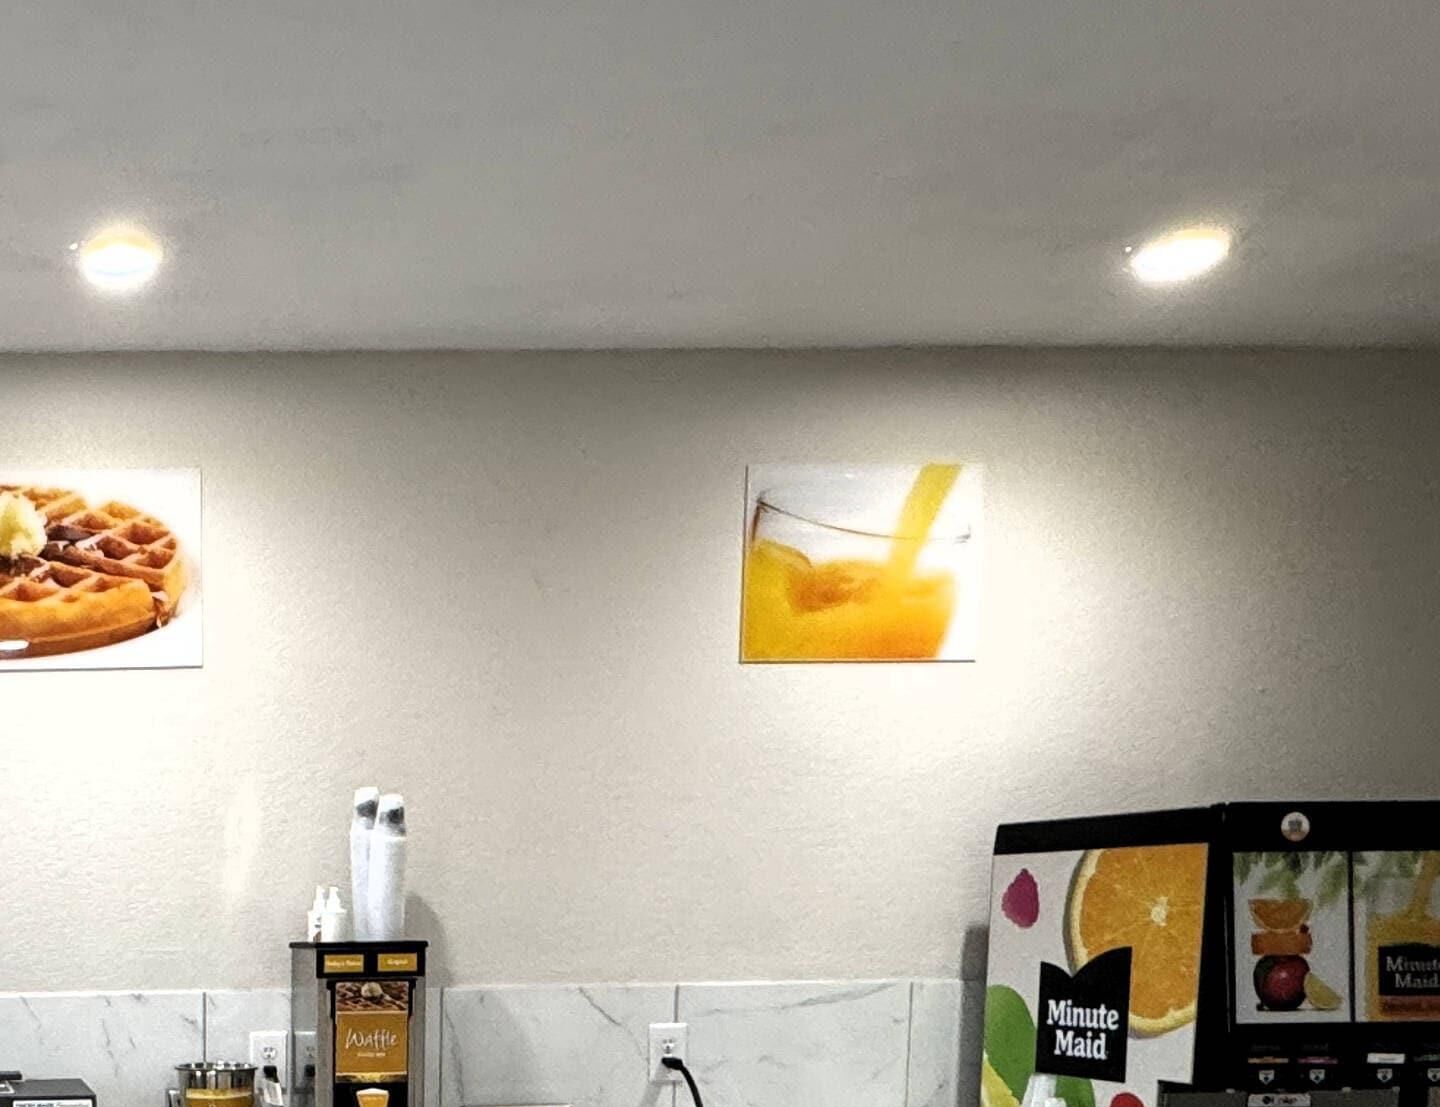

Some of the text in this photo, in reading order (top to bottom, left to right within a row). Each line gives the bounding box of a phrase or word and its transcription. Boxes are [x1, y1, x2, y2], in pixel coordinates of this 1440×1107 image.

[1385, 955, 1440, 973] Minut
[1394, 973, 1440, 989] Maid
[1046, 999, 1119, 1031] Minute
[345, 1028, 398, 1051] Waffle
[1053, 1029, 1107, 1060] Maid
